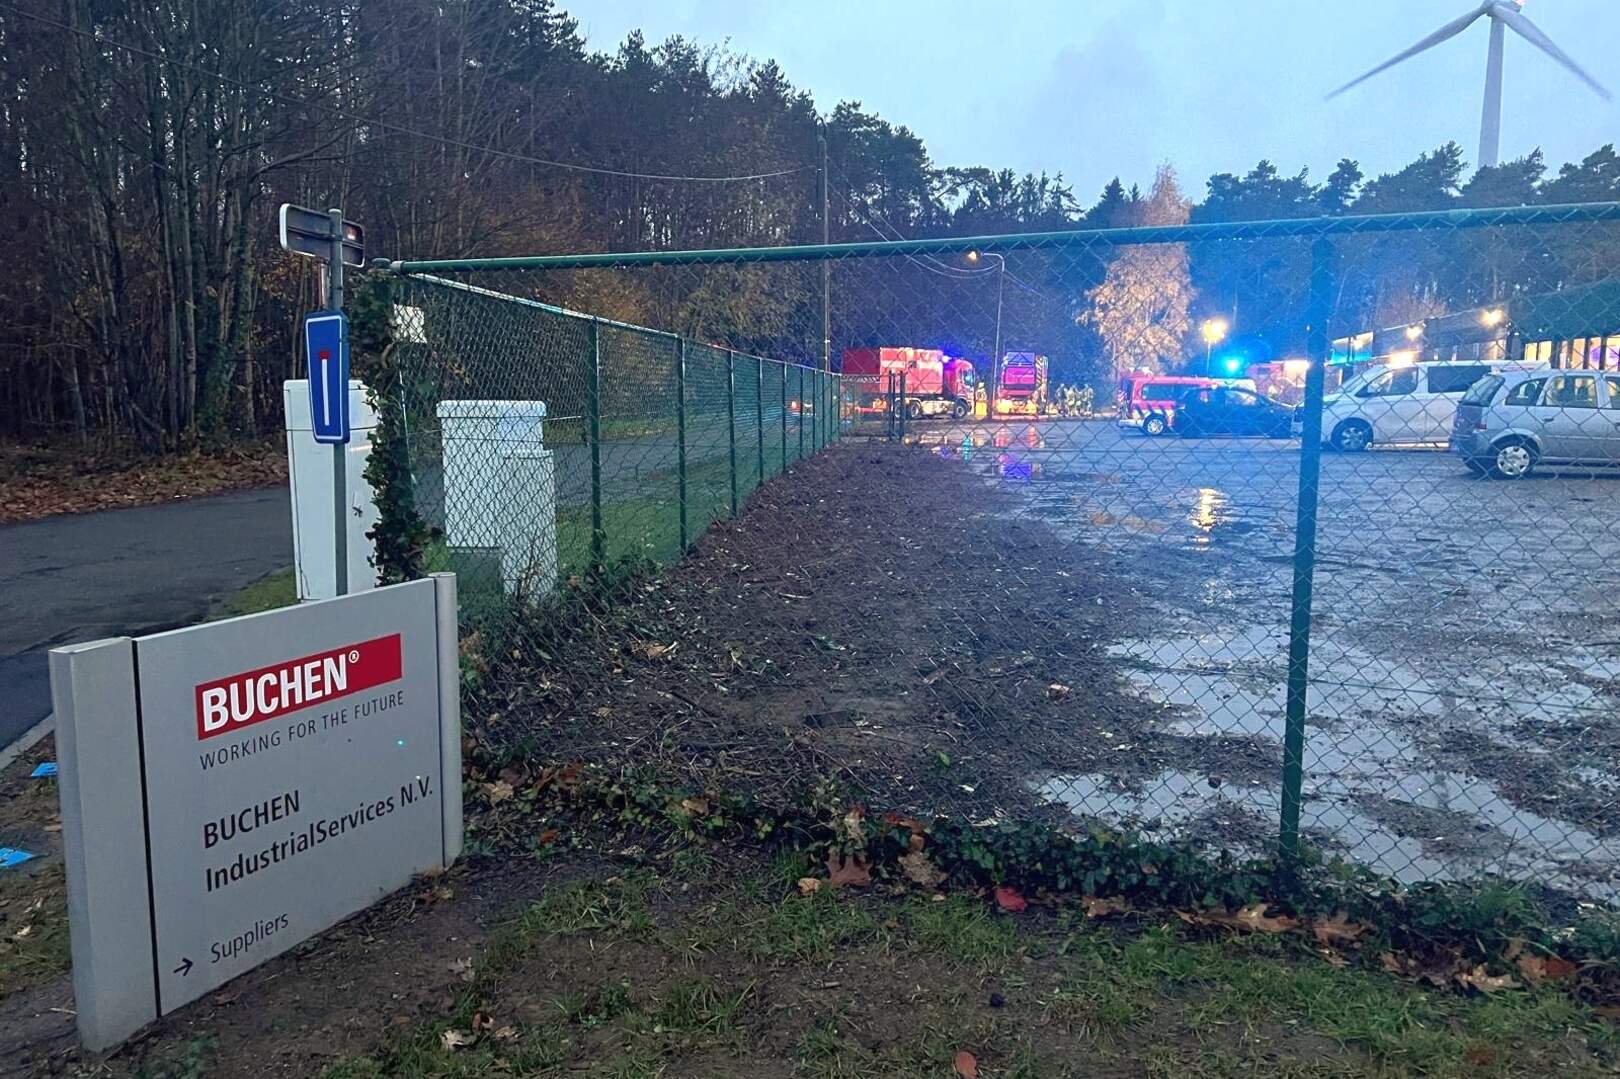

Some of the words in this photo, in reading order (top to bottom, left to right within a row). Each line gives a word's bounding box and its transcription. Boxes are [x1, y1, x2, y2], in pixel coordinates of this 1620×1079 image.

[200, 731, 281, 770] WORKING
[288, 720, 316, 741] FOR
[322, 709, 348, 730] THE
[354, 691, 404, 719] FUTURE
[203, 790, 300, 849] BUCHEN
[205, 796, 394, 892] IndustrialServices
[400, 776, 433, 807] N.V.
[211, 913, 289, 964] Suppliers
